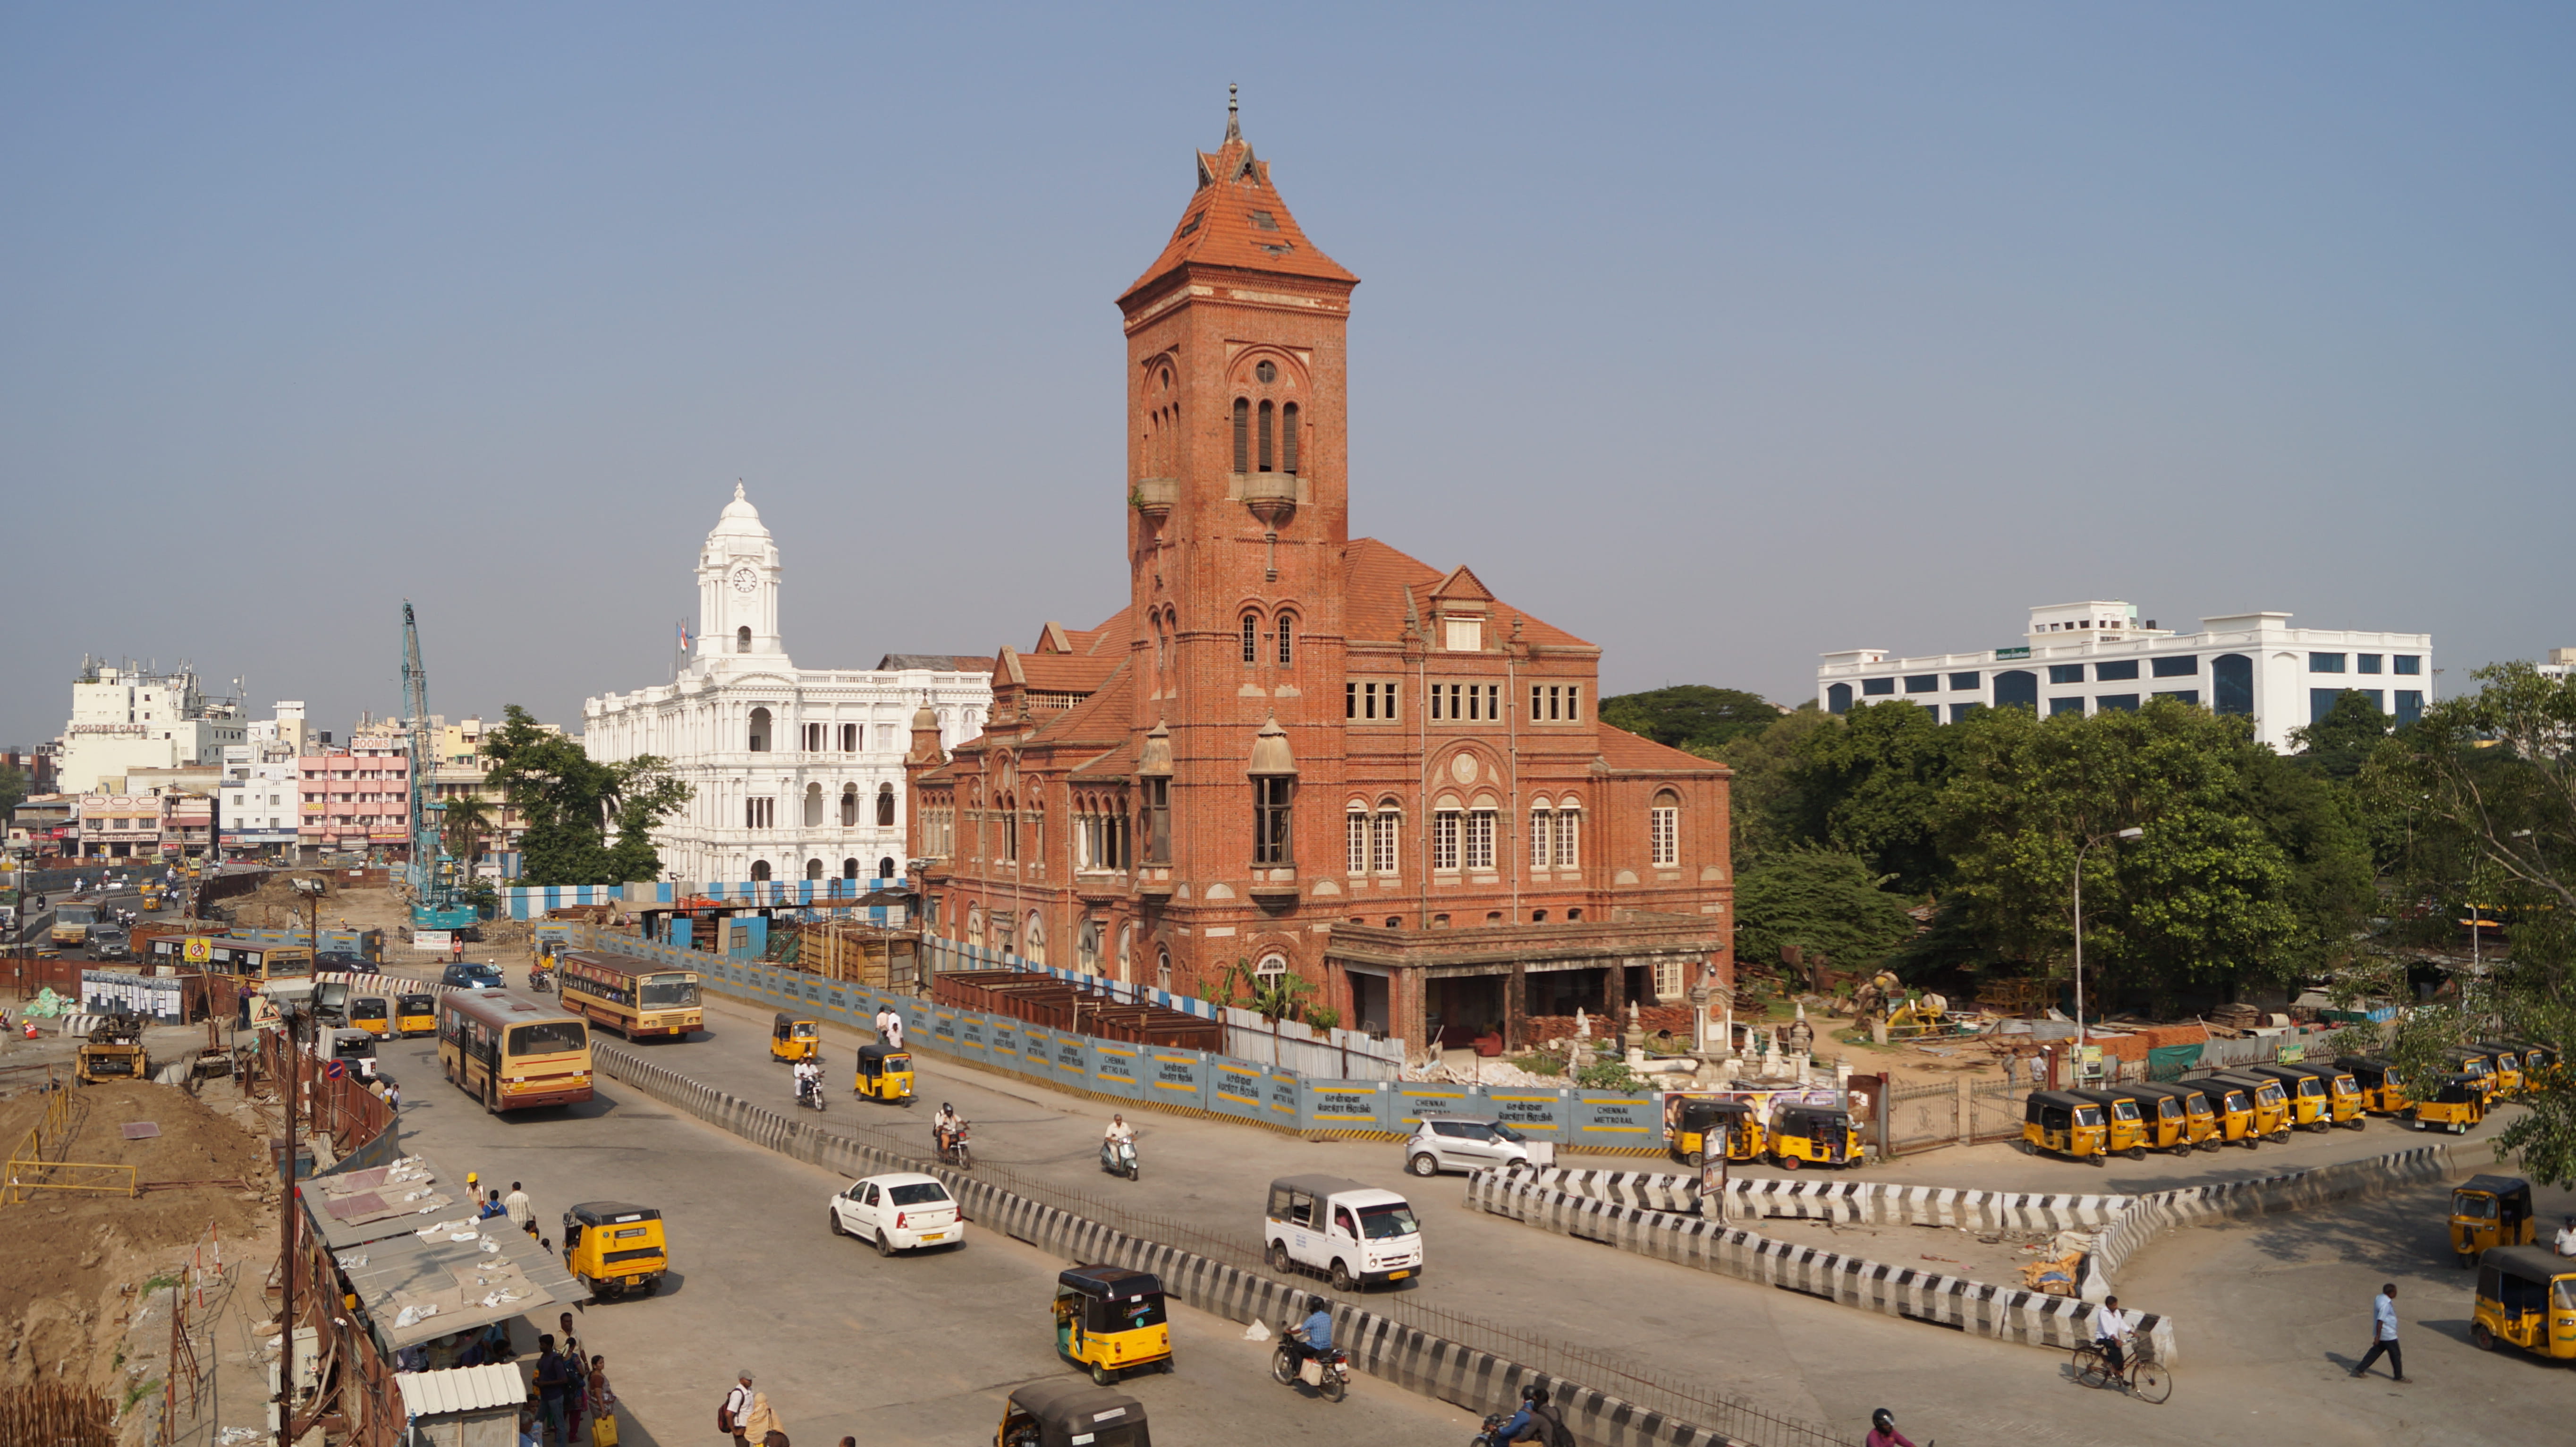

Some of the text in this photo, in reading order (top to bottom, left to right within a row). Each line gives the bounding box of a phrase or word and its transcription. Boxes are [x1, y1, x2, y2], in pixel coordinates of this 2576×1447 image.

[354, 739, 390, 748] ROOMS
[1104, 1055, 1126, 1066] CHENNAI
[1100, 1064, 1130, 1076] METRO RAIL
[1597, 1107, 1628, 1115] CHENNAI
